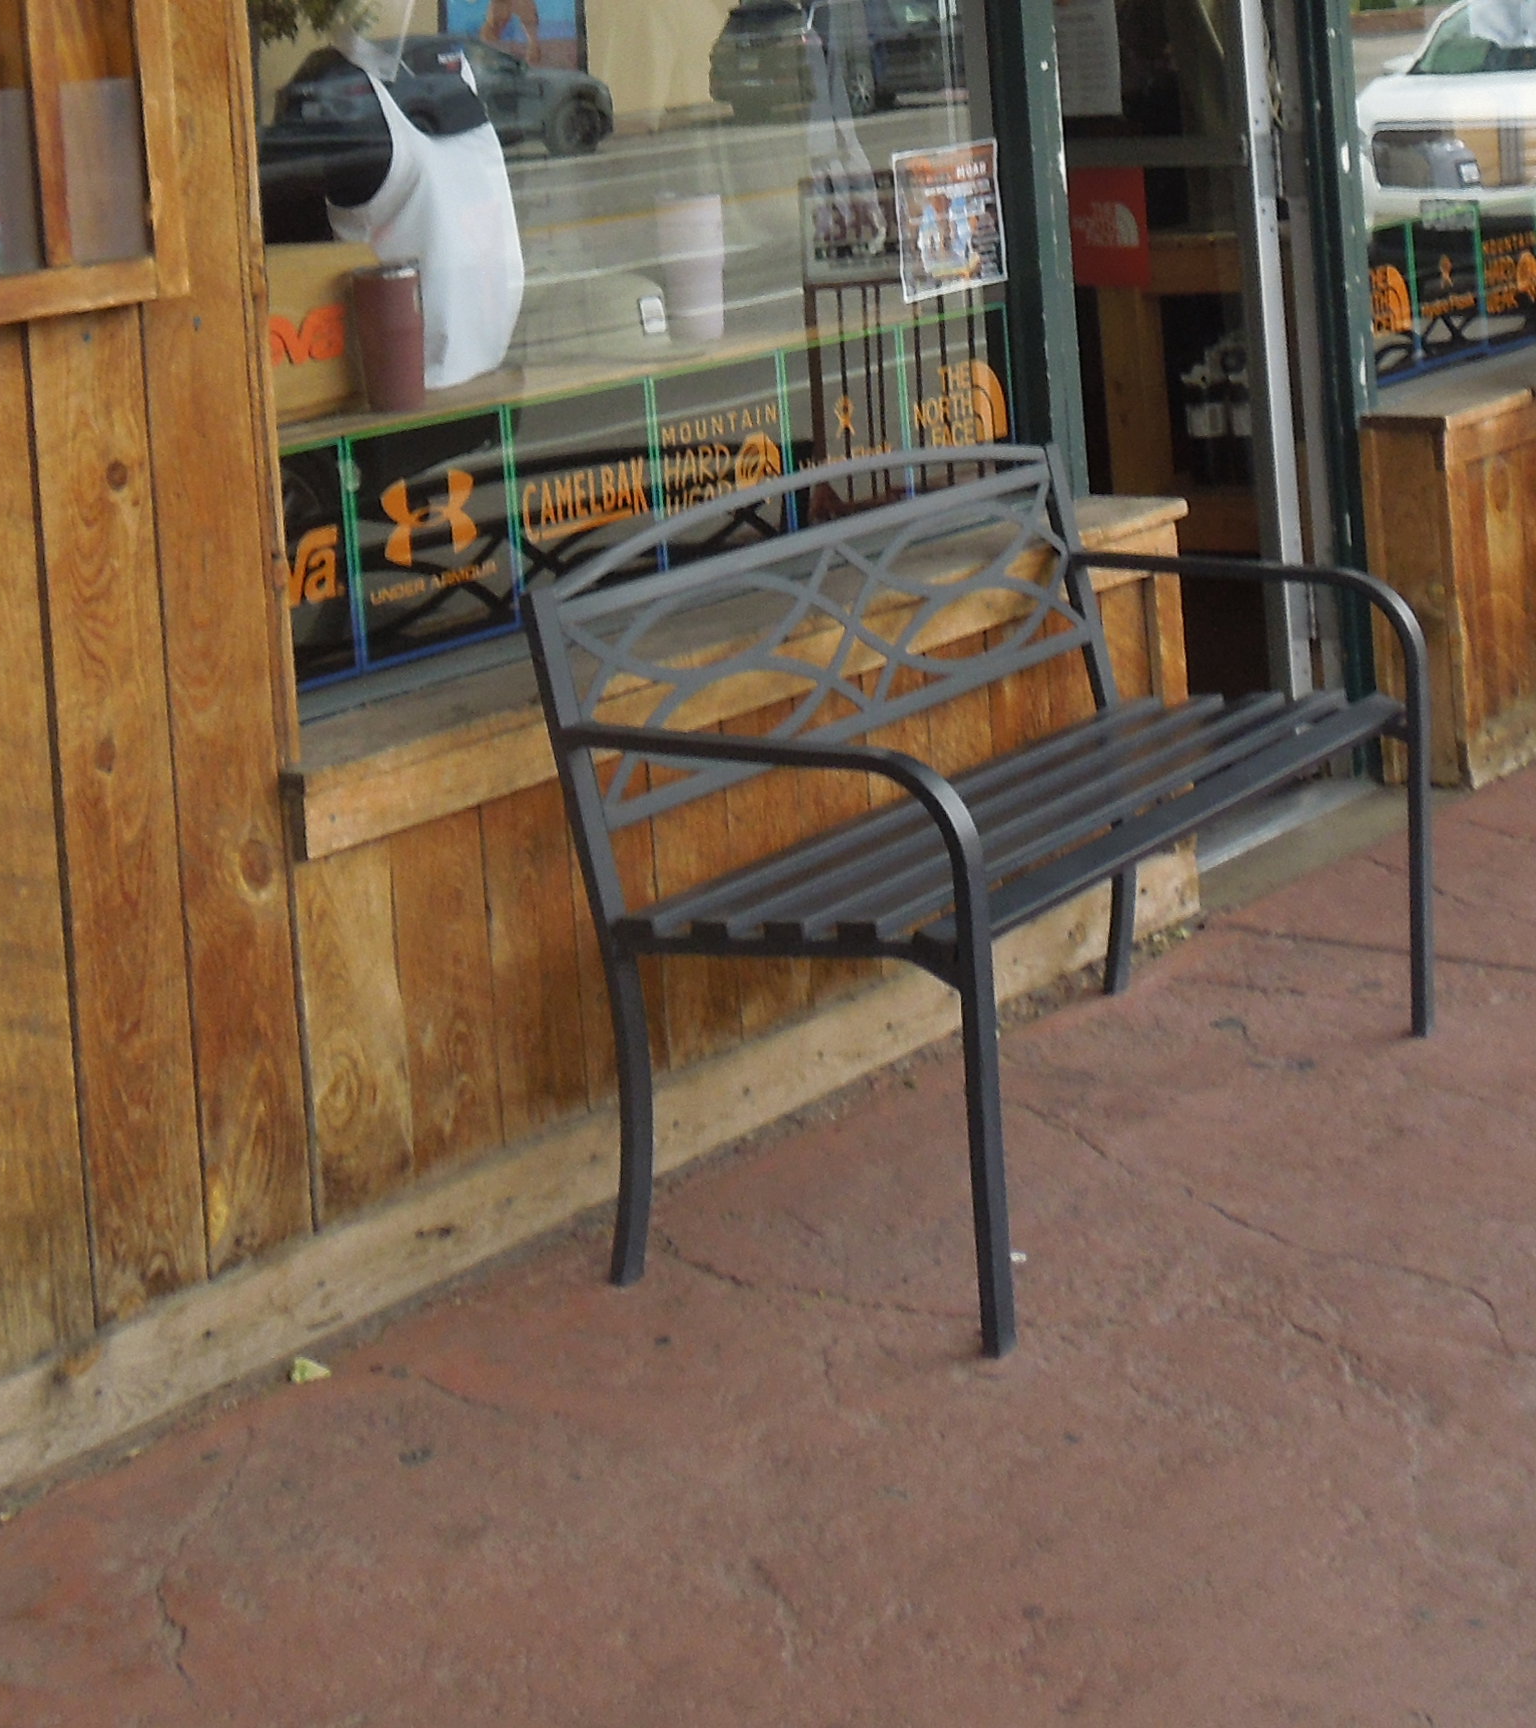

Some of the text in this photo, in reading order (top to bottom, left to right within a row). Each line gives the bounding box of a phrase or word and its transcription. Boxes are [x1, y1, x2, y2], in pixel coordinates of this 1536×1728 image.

[938, 359, 971, 391] THE
[662, 403, 779, 446] MOUNTAIN
[914, 392, 975, 430] NORTH
[664, 443, 731, 492] HARD
[522, 456, 650, 543] CAMELBAK
[370, 577, 426, 606] UNDER
